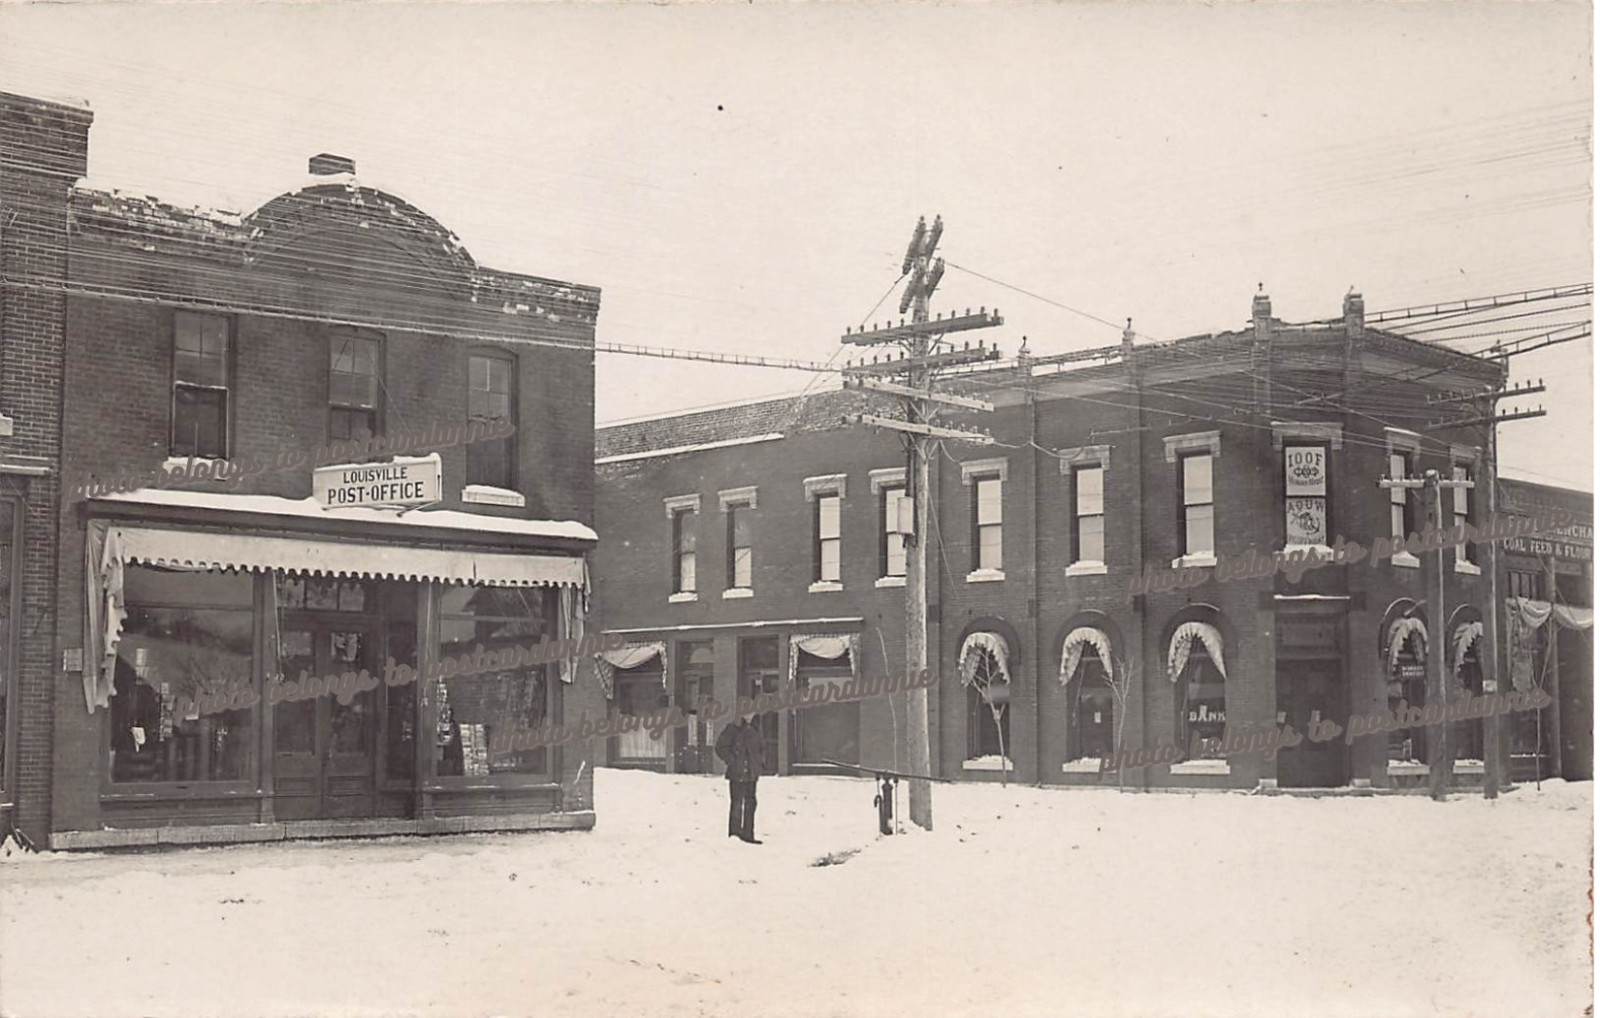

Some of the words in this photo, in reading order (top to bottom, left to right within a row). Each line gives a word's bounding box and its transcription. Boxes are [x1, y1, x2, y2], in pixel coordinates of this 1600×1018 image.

[343, 467, 408, 484] LOUISVILLE
[328, 482, 424, 505] POST-OFFICE
[1503, 538, 1526, 552] COAL
[1530, 540, 1552, 554] FEED
[1189, 705, 1226, 722] BANK
